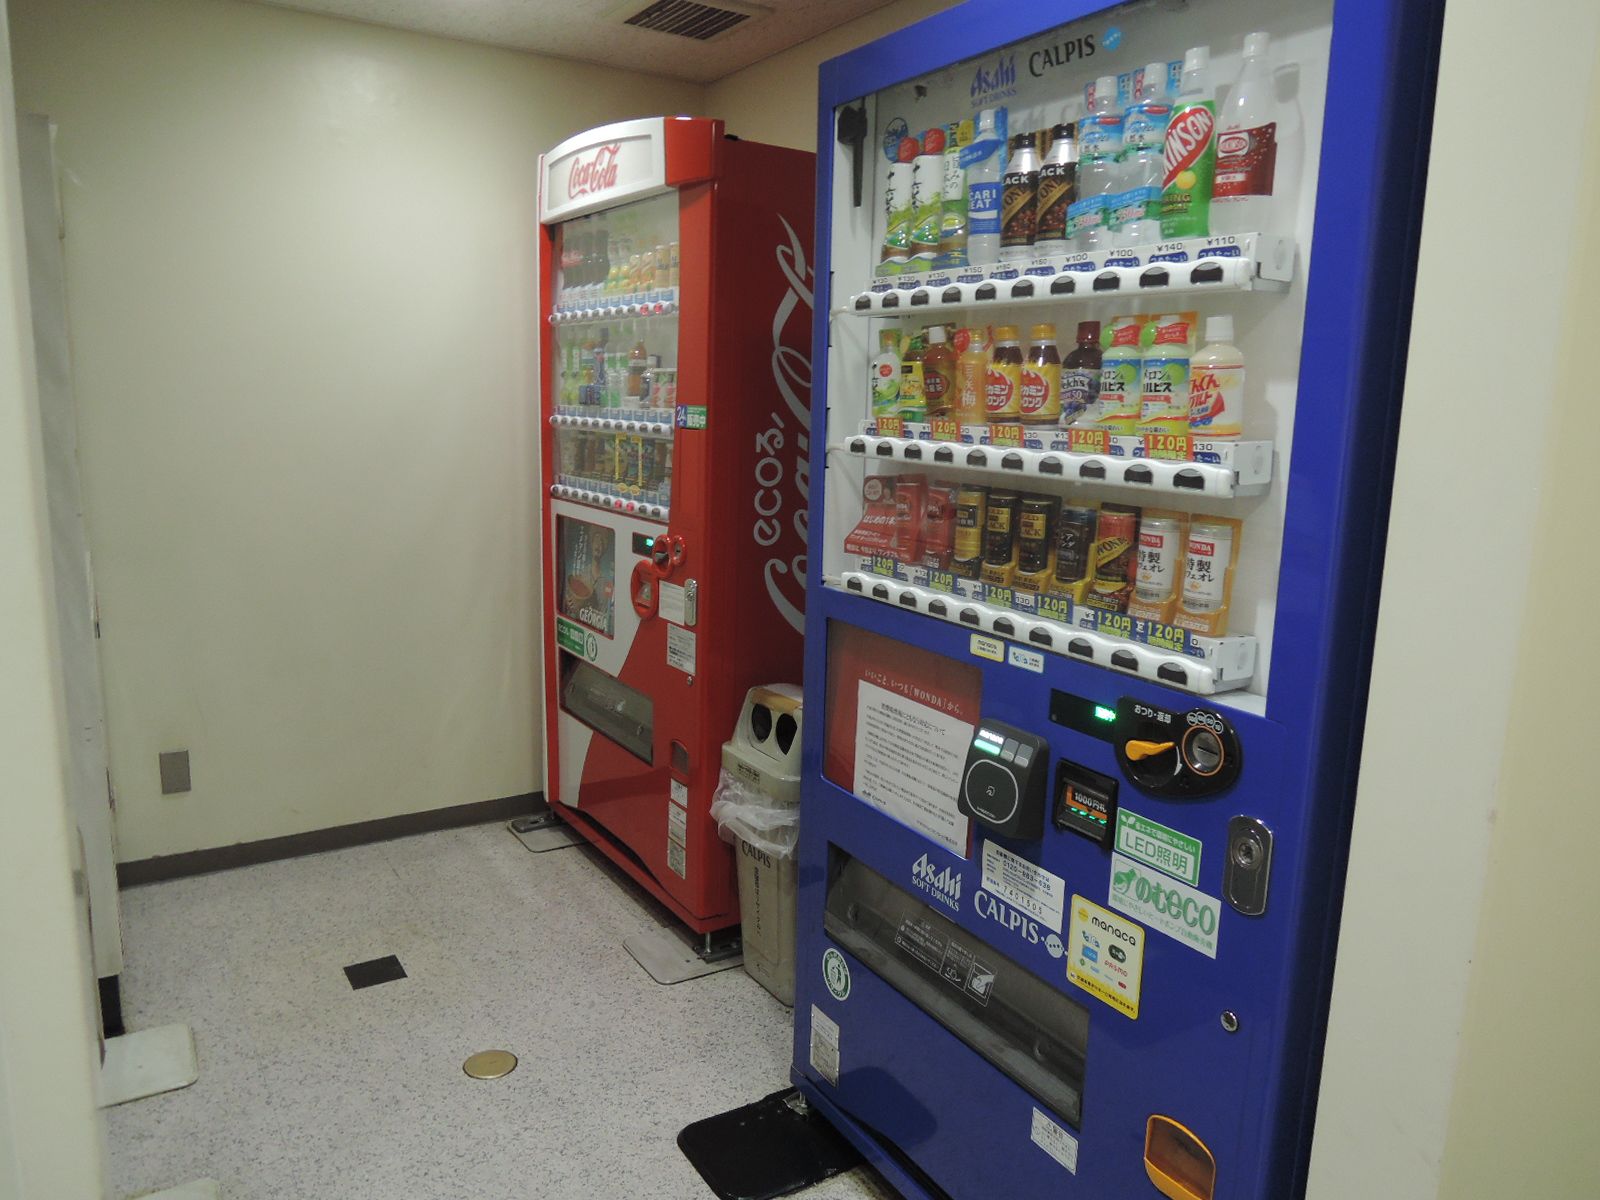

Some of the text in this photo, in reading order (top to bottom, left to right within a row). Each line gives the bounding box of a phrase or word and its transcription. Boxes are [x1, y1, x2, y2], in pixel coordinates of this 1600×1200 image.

[1029, 34, 1096, 78] CALPIS
[970, 53, 1017, 98] Asahi
[1066, 253, 1088, 262] ¥100
[1109, 249, 1133, 257] ¥100
[1157, 243, 1183, 252] ¥140
[1207, 236, 1235, 246] ¥110
[878, 418, 899, 430] 120円
[932, 420, 957, 434] 120円
[992, 426, 1020, 440] 120円
[1071, 430, 1104, 444] 120円
[1149, 435, 1187, 450] 120円
[1037, 595, 1067, 614] 120円
[1098, 611, 1132, 631] 120円
[1147, 621, 1184, 643] 120円
[741, 840, 772, 869] CALPIS
[1125, 831, 1188, 875] LED照明
[912, 853, 962, 900] Asahi
[911, 875, 960, 913] SOFT DRINKS
[973, 890, 1039, 945] CALPIS
[1091, 916, 1136, 946] manaca
